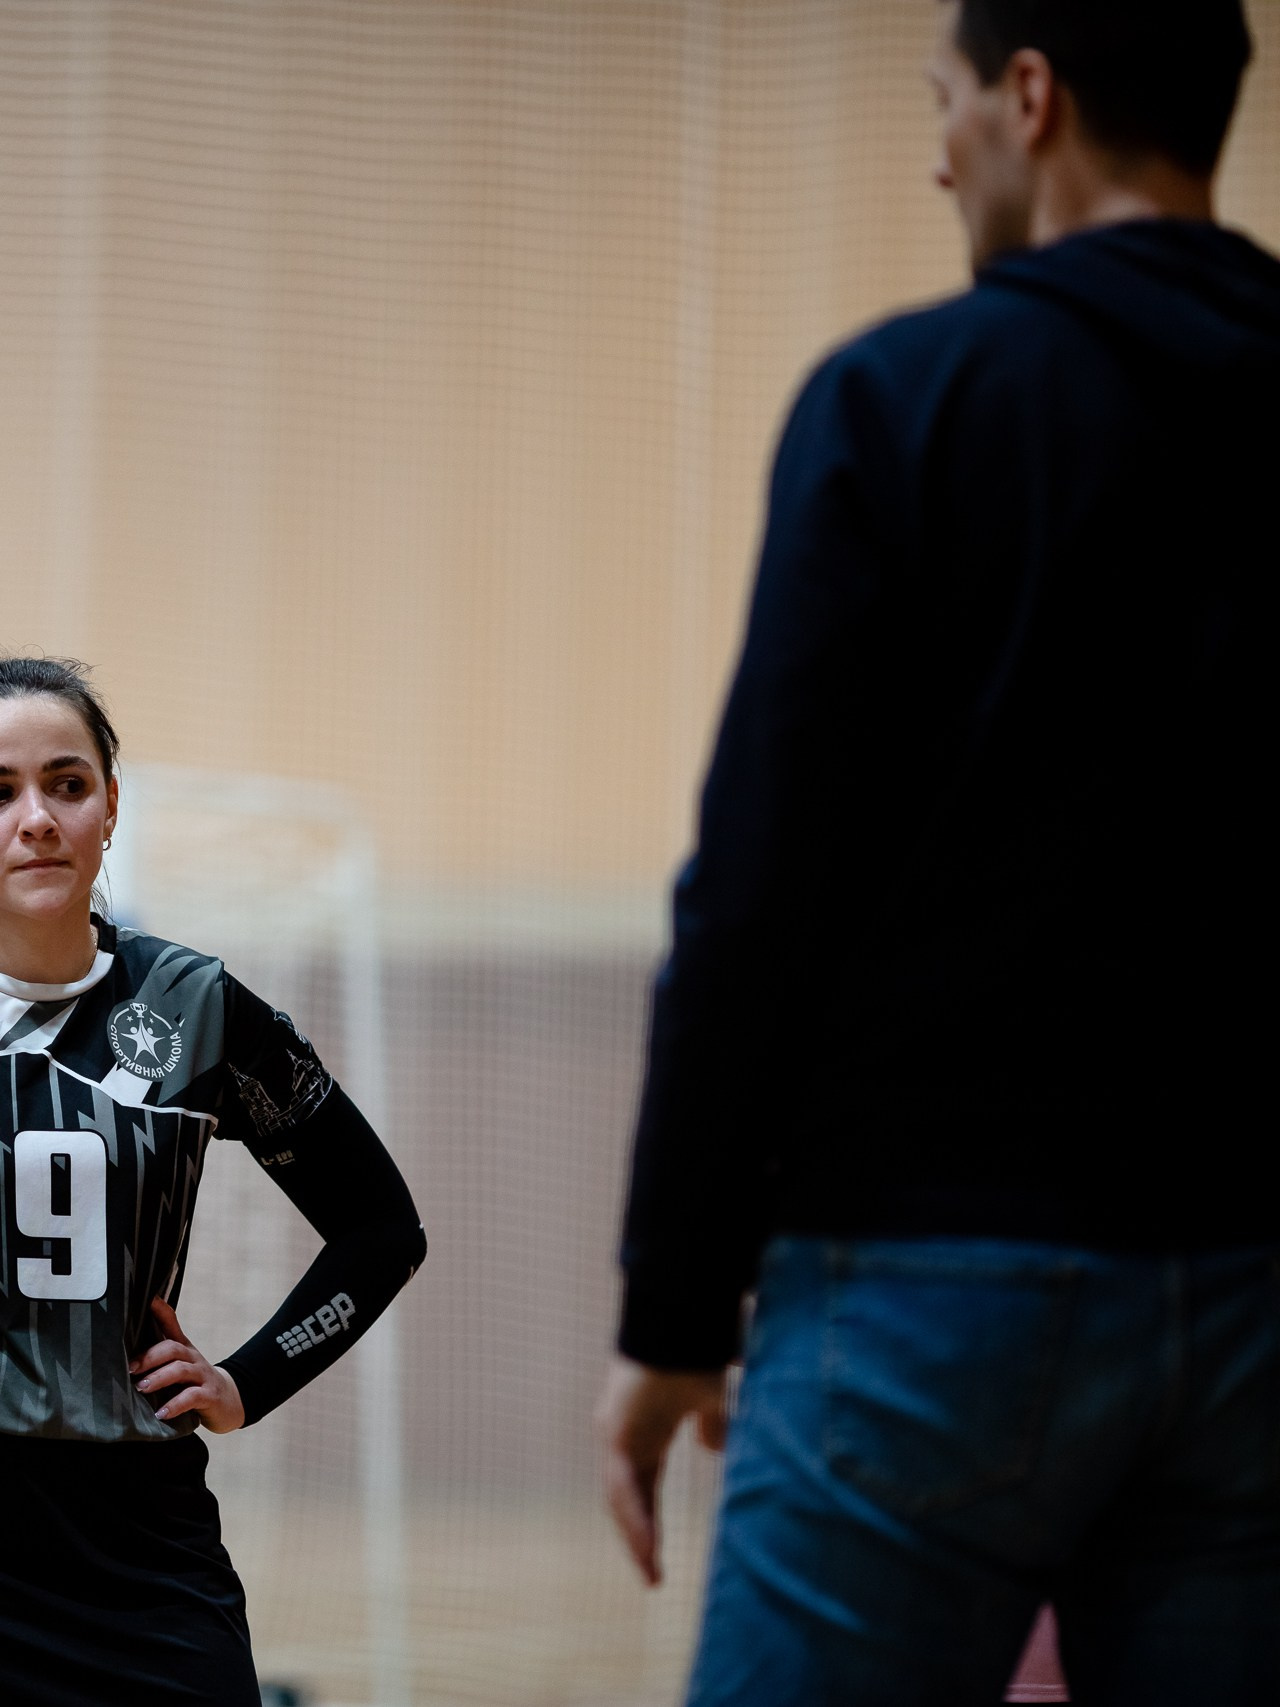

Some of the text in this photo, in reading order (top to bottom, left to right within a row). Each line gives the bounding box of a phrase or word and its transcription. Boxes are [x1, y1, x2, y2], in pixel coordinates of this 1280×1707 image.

[111, 1024, 182, 1078] СПОРТИВНАЯ ШКОЛА
[14, 1130, 108, 1300] 9
[301, 1292, 356, 1345] cep
